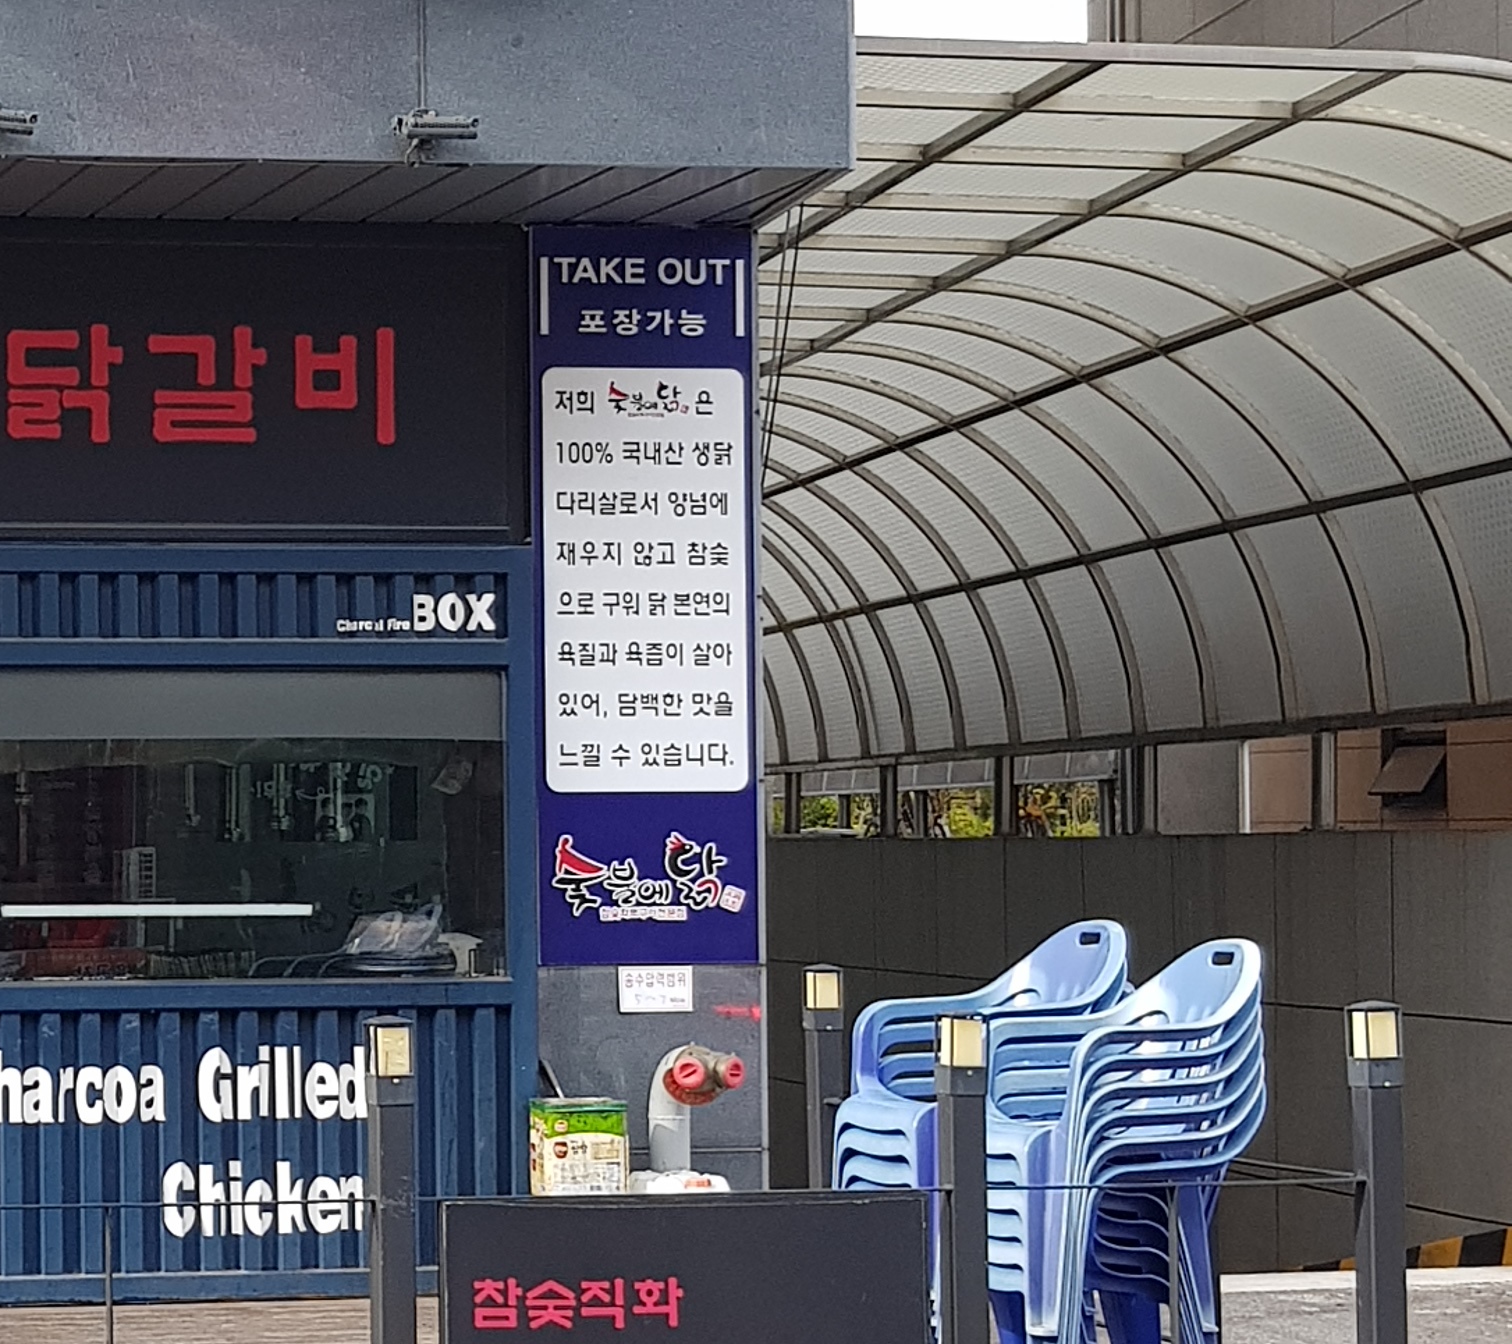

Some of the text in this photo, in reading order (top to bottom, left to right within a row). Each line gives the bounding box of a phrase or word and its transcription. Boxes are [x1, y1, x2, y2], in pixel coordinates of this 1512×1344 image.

[553, 256, 730, 285] TAKE OUT
[578, 309, 706, 337] 포장가능
[555, 389, 595, 415] 저희
[695, 390, 714, 415] 은
[556, 441, 733, 467] 100% 국내산 생닭
[556, 491, 729, 517] 다리살로서 양념에
[556, 541, 730, 566] 재우지 않고 참숯
[413, 592, 496, 632] BOX
[557, 591, 731, 616] 으로 구워 닭 본연의
[558, 641, 733, 667] 육질과 육즙이 살아
[559, 691, 734, 718] 있어, 담백한 맛을
[559, 742, 734, 767] 느낄 수 있습니다.
[625, 972, 686, 988] 송수압력범위
[197, 1044, 368, 1124] Grilled
[162, 1160, 364, 1238] Chicken
[472, 1276, 684, 1329] 참숯직화
